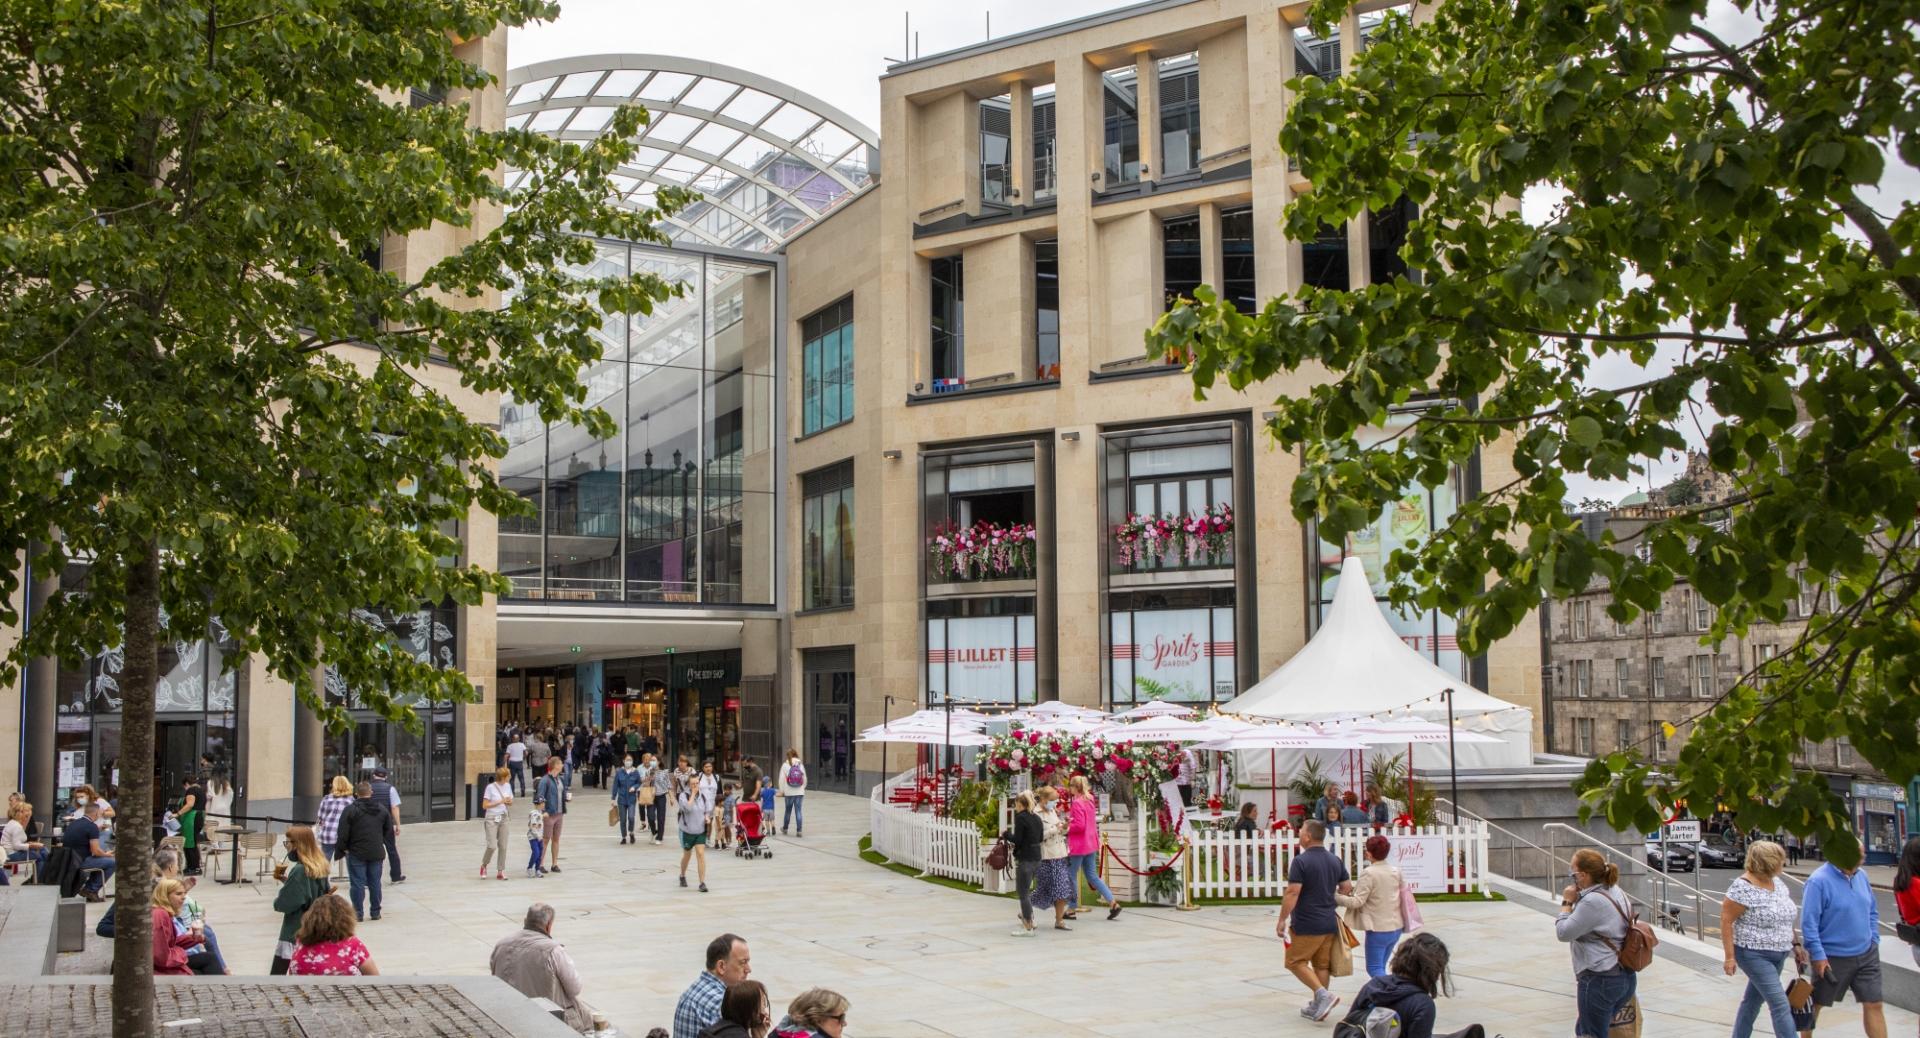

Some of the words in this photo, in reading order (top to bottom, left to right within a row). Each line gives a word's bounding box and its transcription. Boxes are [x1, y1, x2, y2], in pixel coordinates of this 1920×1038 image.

[957, 648, 1007, 662] LILLET
[1142, 633, 1200, 670] Spritz
[694, 671, 702, 679] THE
[702, 670, 712, 679] BODY
[713, 670, 724, 678] SHOP
[1391, 842, 1425, 862] Spritz
